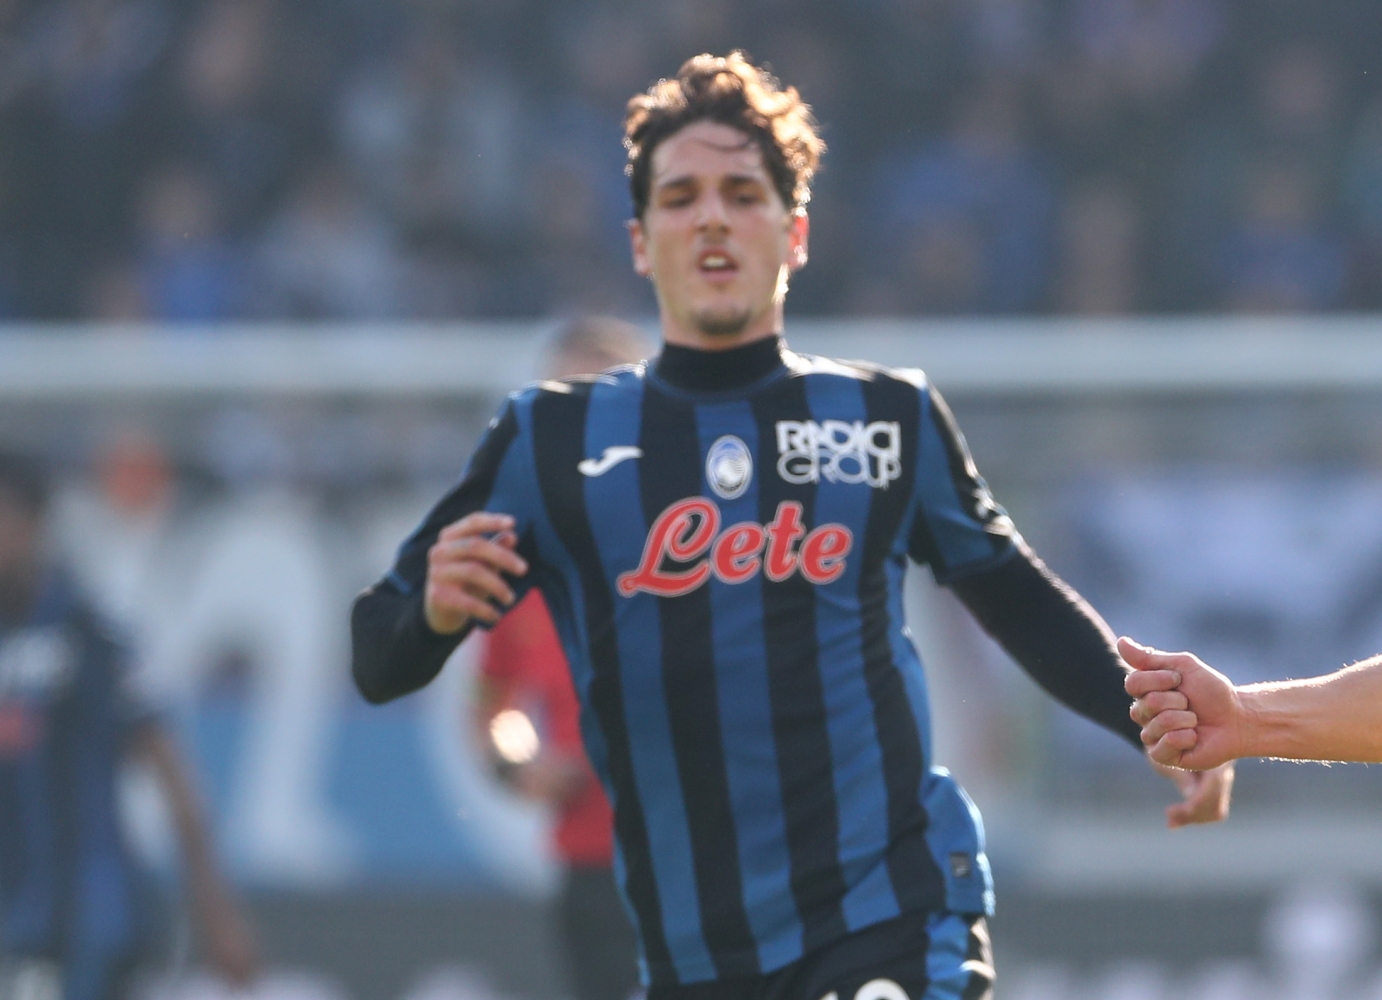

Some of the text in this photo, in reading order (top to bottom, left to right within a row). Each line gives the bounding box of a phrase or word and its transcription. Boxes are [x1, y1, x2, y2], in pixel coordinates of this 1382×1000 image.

[775, 420, 900, 461] RADICI
[776, 452, 902, 490] GROUP
[616, 495, 853, 597] Lete
